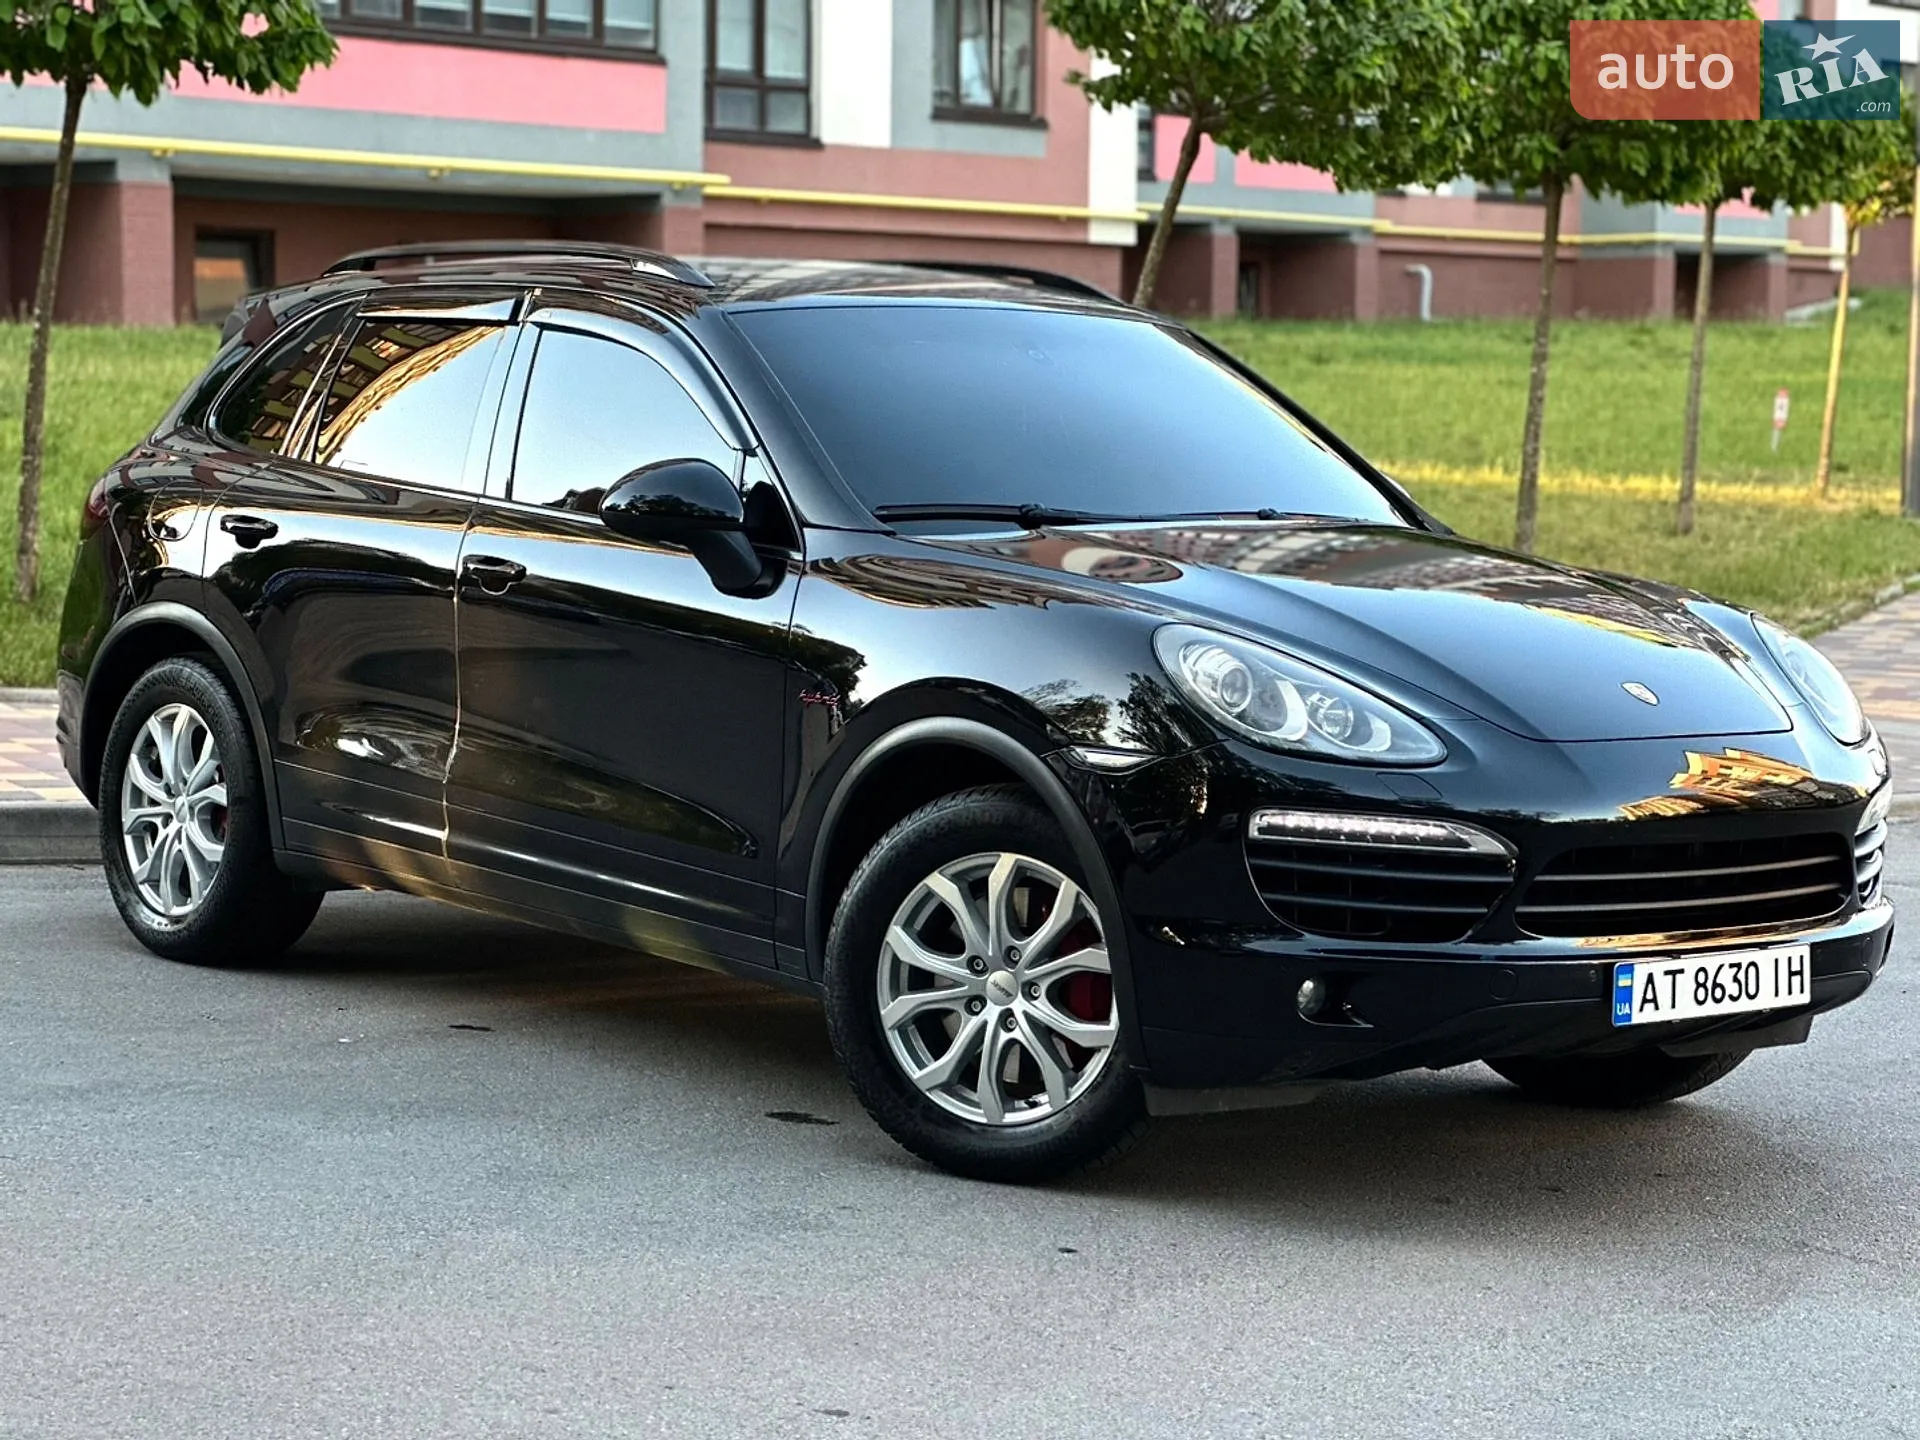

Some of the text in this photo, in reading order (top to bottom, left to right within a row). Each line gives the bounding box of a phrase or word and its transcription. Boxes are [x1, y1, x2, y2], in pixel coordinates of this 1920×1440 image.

[1639, 955, 1805, 1012] AT 8630 IH
[1616, 1002, 1631, 1016] UA
